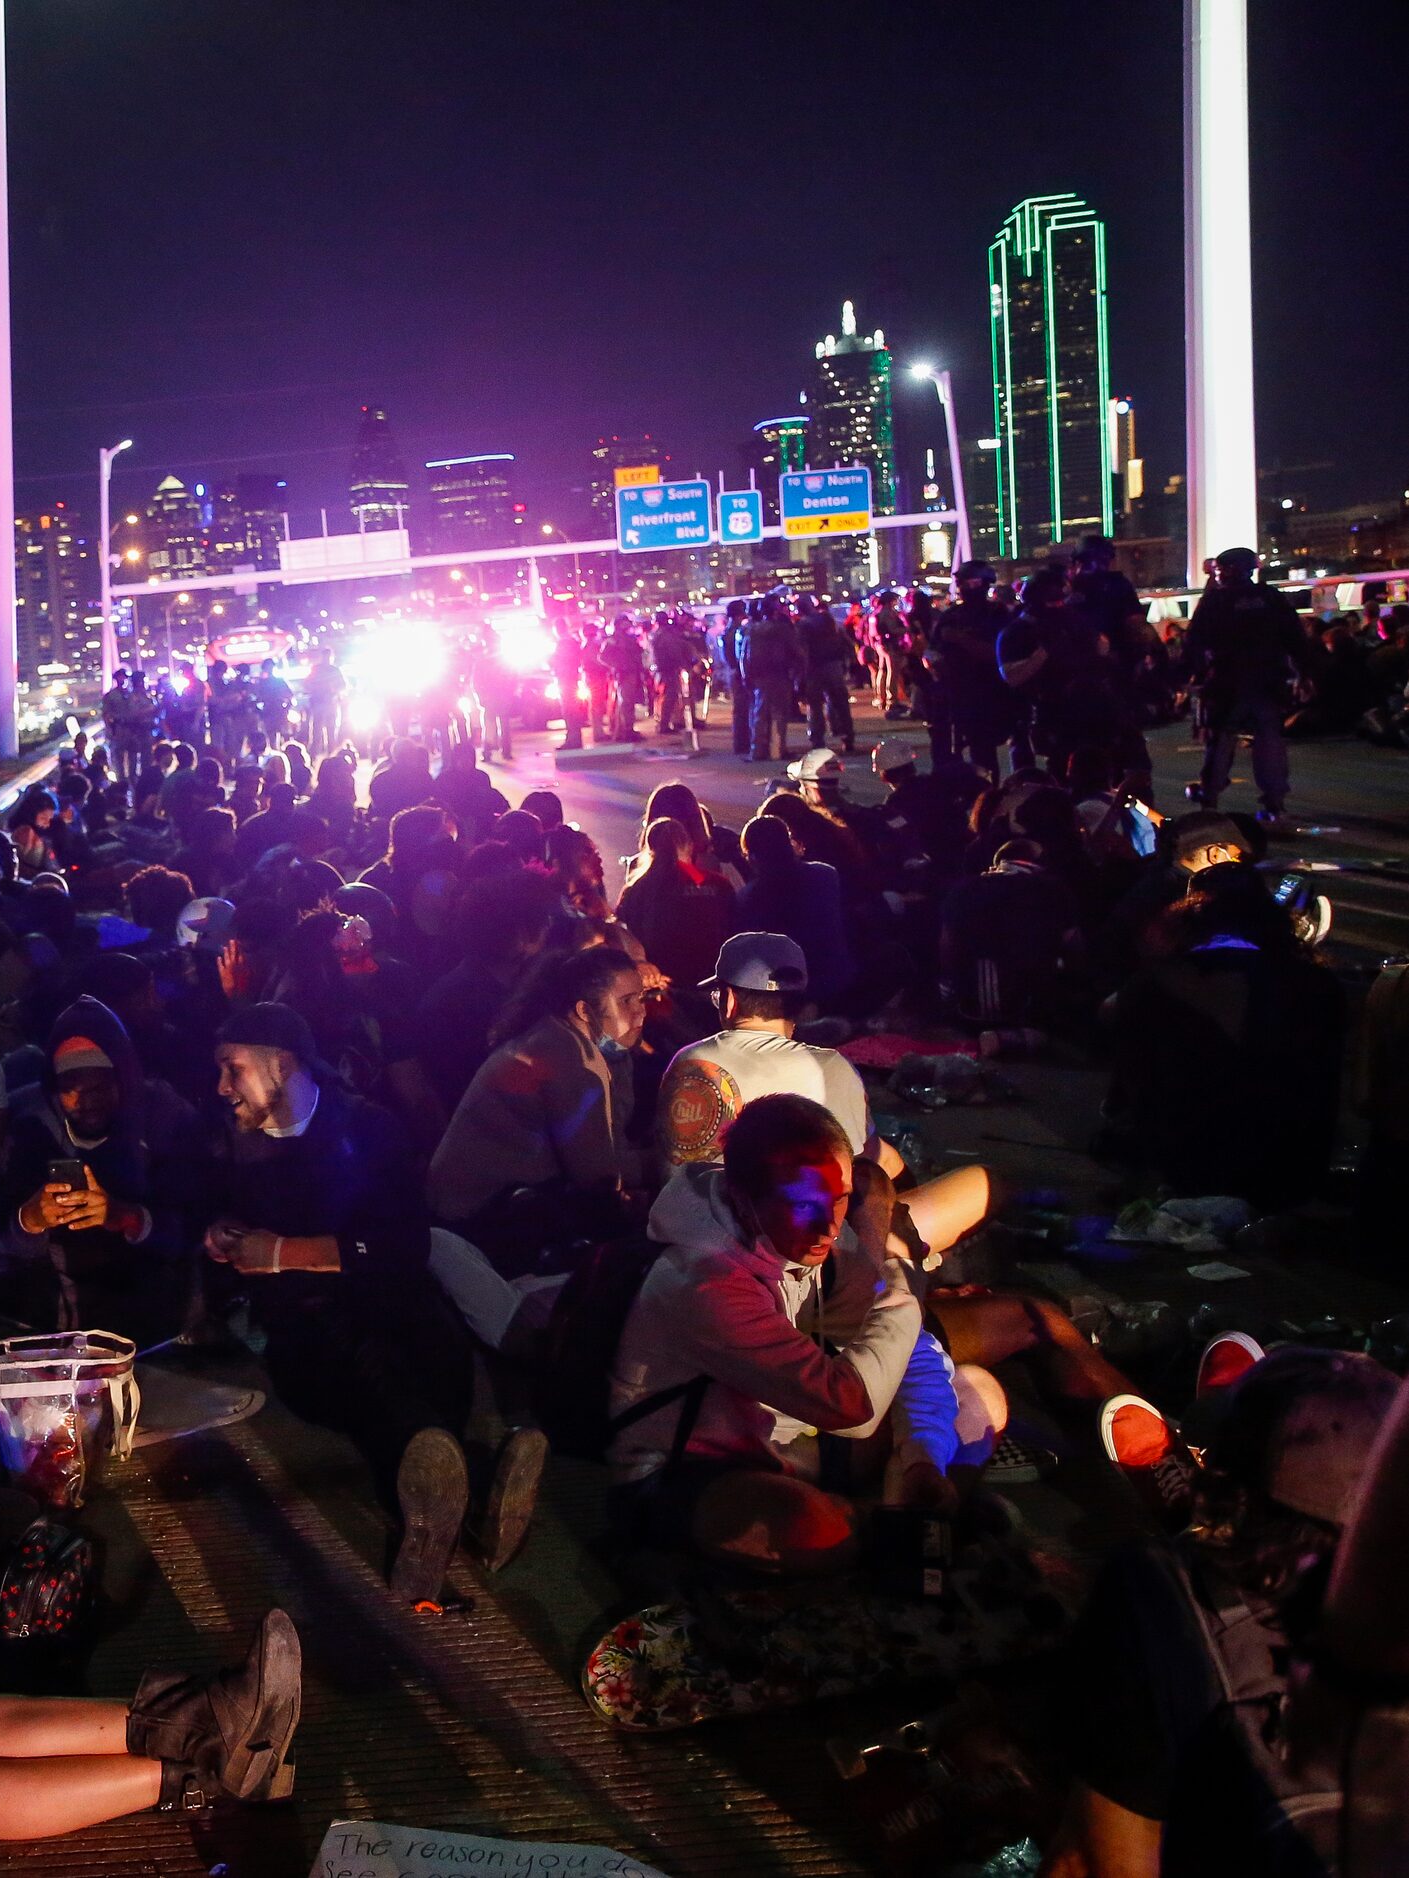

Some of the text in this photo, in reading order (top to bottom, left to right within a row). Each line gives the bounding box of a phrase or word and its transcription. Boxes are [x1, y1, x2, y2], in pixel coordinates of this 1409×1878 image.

[787, 477, 801, 487] TO
[623, 491, 638, 501] TO
[802, 495, 850, 509] Denton
[732, 498, 749, 509] TO
[631, 509, 697, 527] Riverfront
[731, 516, 750, 530] 75
[675, 525, 705, 540] Blvd
[335, 1833, 393, 1857] The
[405, 1839, 505, 1866] reason
[515, 1854, 587, 1878] you
